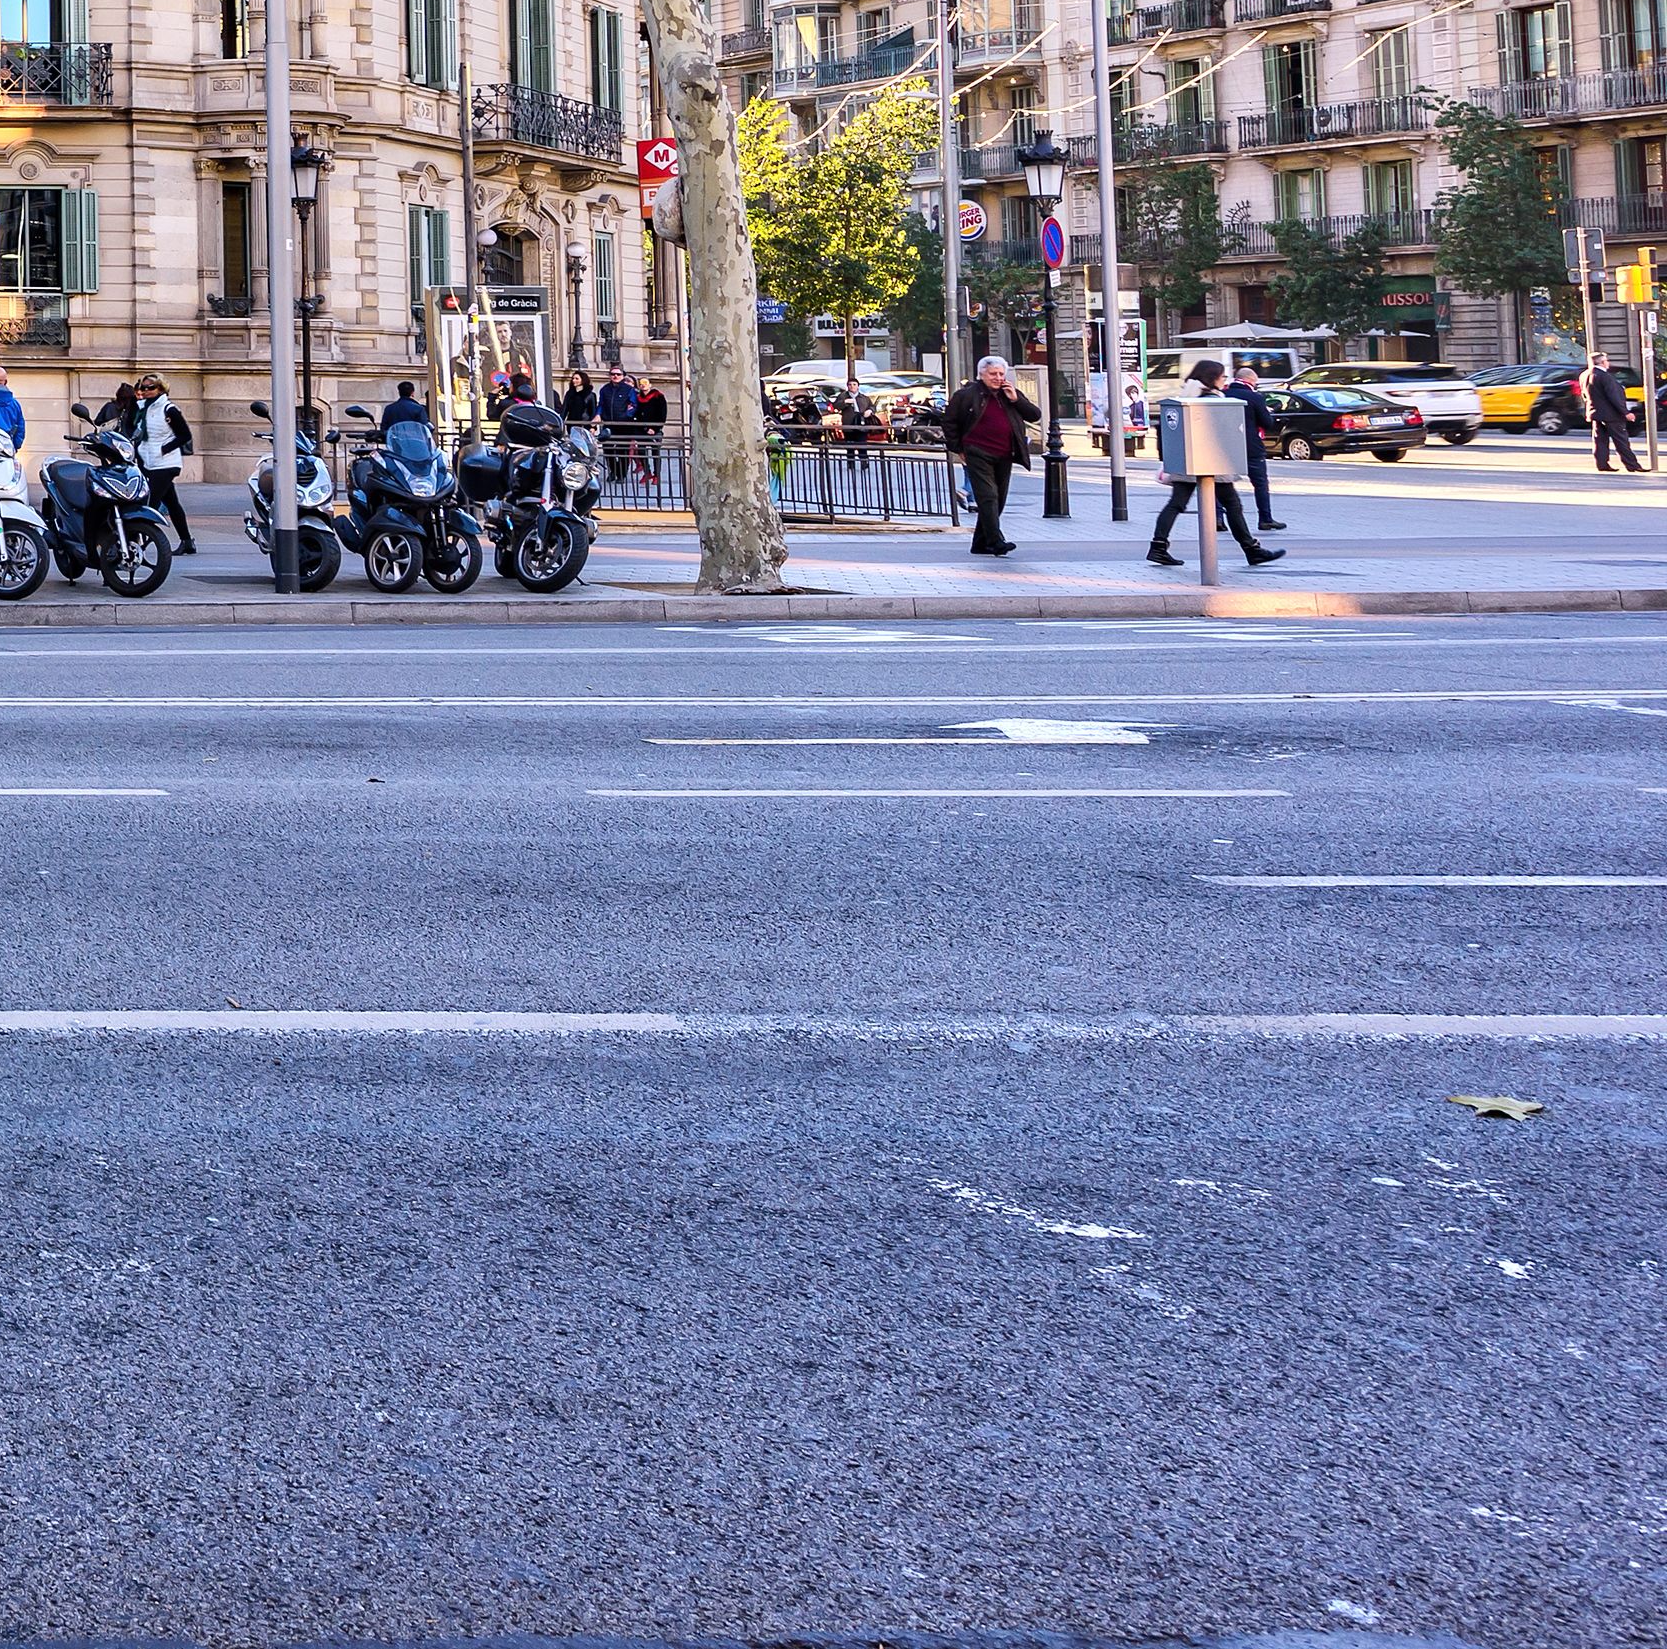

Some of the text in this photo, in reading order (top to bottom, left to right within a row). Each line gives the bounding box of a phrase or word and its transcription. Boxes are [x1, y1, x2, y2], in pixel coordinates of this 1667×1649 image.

[654, 149, 670, 163] M
[959, 207, 980, 219] RGER
[960, 214, 983, 230] ING
